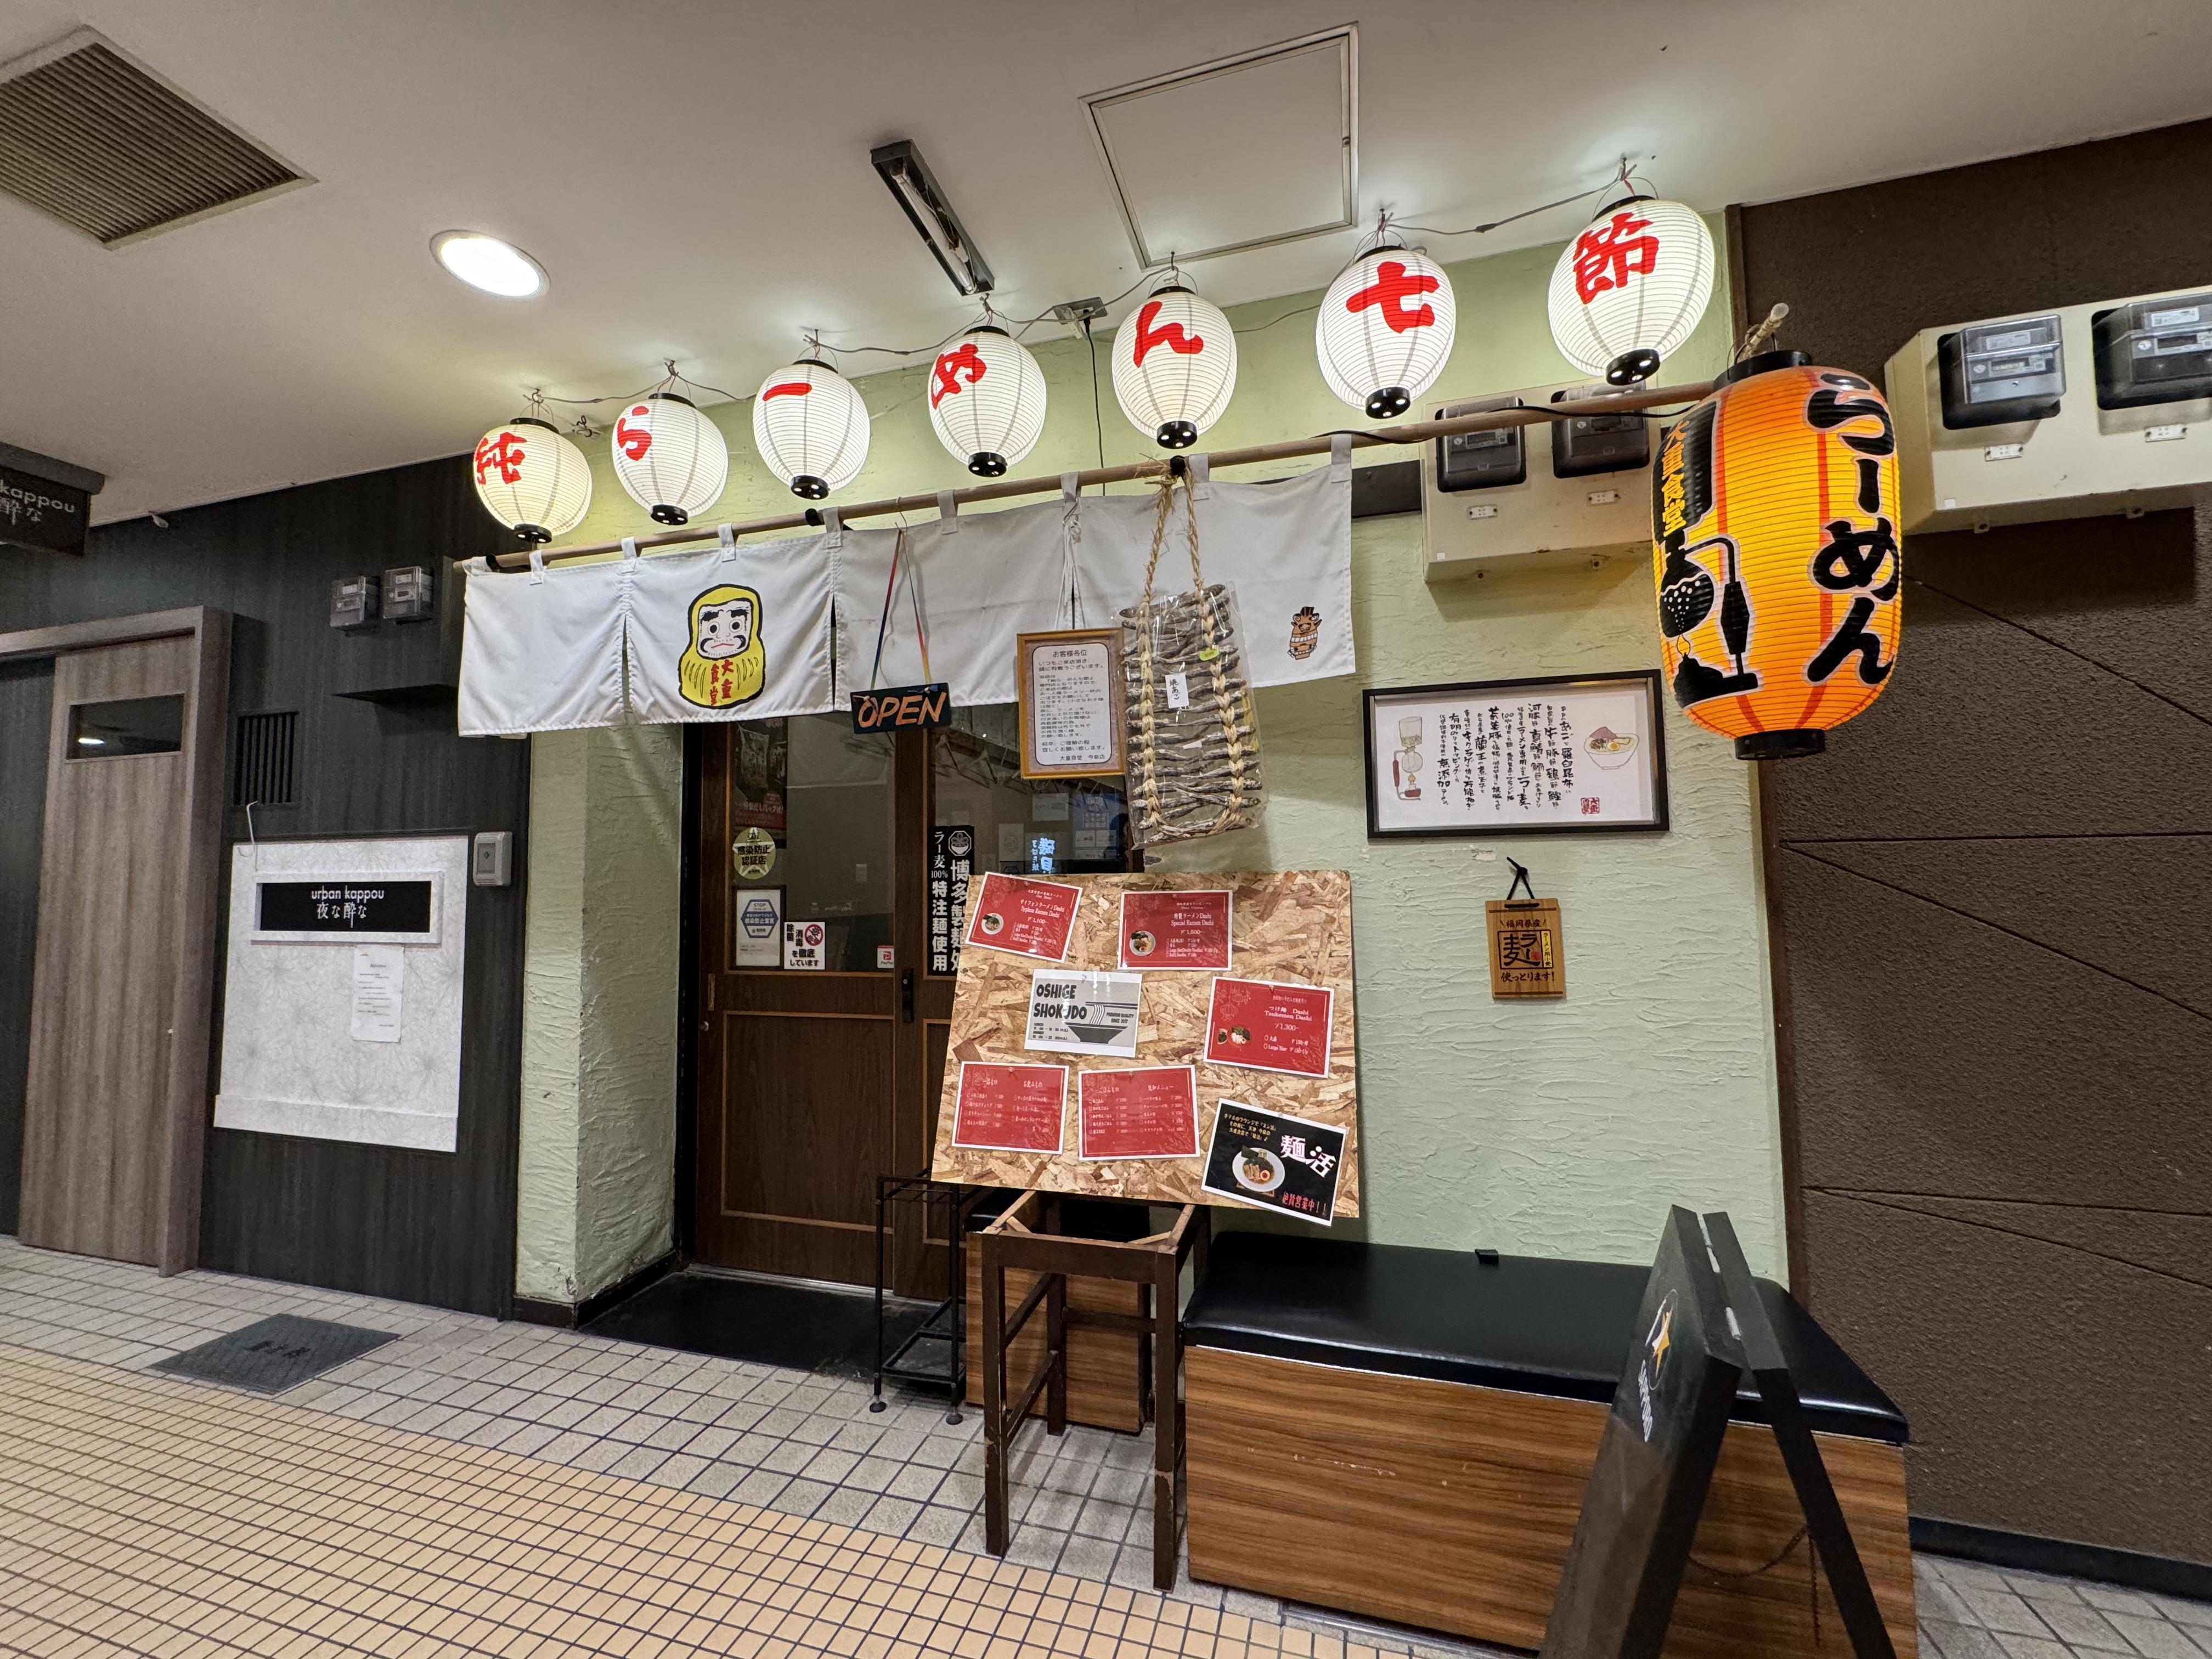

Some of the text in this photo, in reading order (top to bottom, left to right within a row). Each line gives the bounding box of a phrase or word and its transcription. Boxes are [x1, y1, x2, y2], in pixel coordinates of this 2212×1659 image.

[618, 405, 652, 461] ら
[931, 342, 986, 409] め
[1133, 301, 1204, 367] ん
[1346, 261, 1440, 334] 七
[1572, 212, 1658, 305] 節
[1661, 419, 1690, 538] 大重食堂
[0, 479, 75, 514] kappou
[1804, 373, 1900, 685] らーめん
[1053, 650, 1087, 658] お客様各位
[859, 692, 947, 728] OPEN
[737, 845, 771, 856] 感染防止
[742, 856, 766, 866] 認証店
[311, 885, 385, 904] urban kappou
[317, 902, 366, 928] 夜な酔な
[1506, 919, 1542, 928] 福岡県産
[787, 924, 794, 941] 除菌
[795, 929, 803, 947] 消毒
[792, 949, 815, 958] を徹底
[1036, 983, 1077, 999] OSHIGE
[1264, 1010, 1294, 1019] Tsukemen
[1280, 1135, 1337, 1178] 麺活
